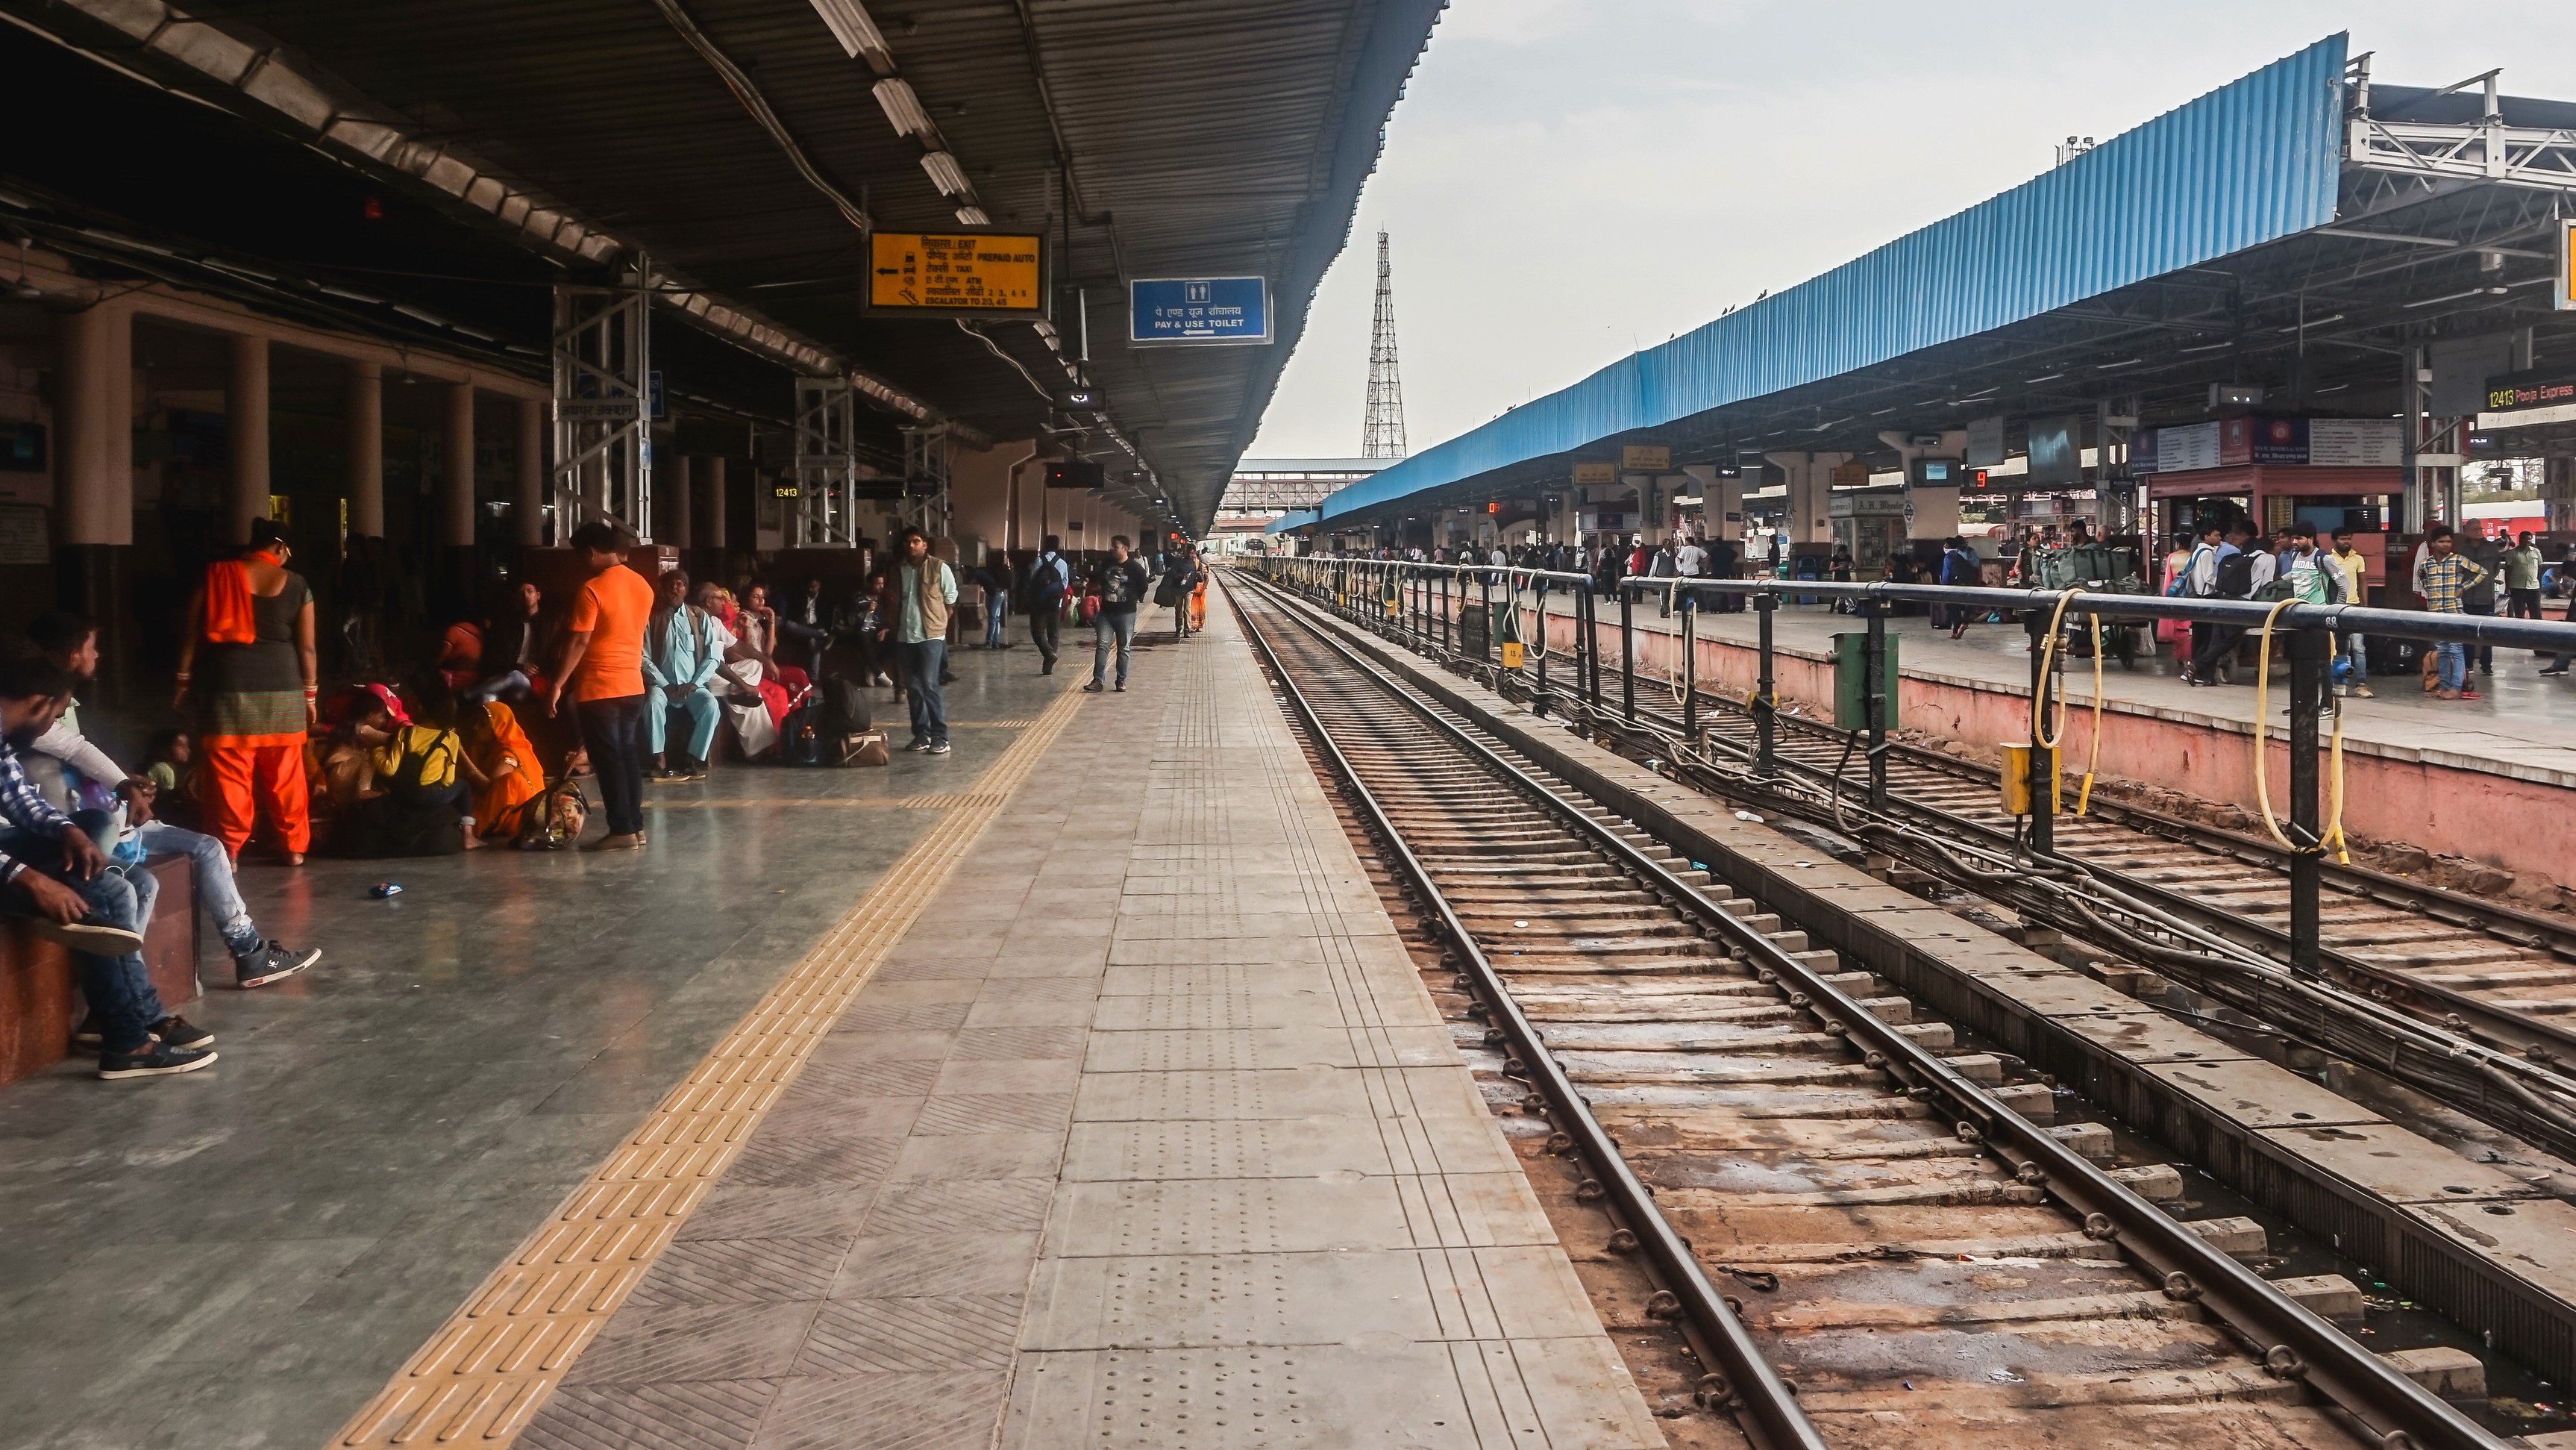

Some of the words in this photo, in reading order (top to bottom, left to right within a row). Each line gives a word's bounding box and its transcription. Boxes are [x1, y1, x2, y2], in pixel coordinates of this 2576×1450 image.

[958, 240, 977, 249] EXIT
[977, 253, 1012, 262] PREPAID
[1013, 253, 1035, 262] AUTO
[956, 265, 972, 273] TAXI
[966, 277, 982, 285] ATM
[1155, 305, 1162, 316] पे
[1167, 308, 1184, 318] एण्ड
[1208, 303, 1241, 316] शौचालय
[1185, 320, 1205, 328] USE
[1209, 319, 1244, 328] TOILET
[2489, 390, 2514, 408] 12413
[2516, 390, 2537, 403] Pooja
[2540, 385, 2574, 400] Express
[1976, 471, 1986, 488] 9
[776, 488, 798, 498] 12413
